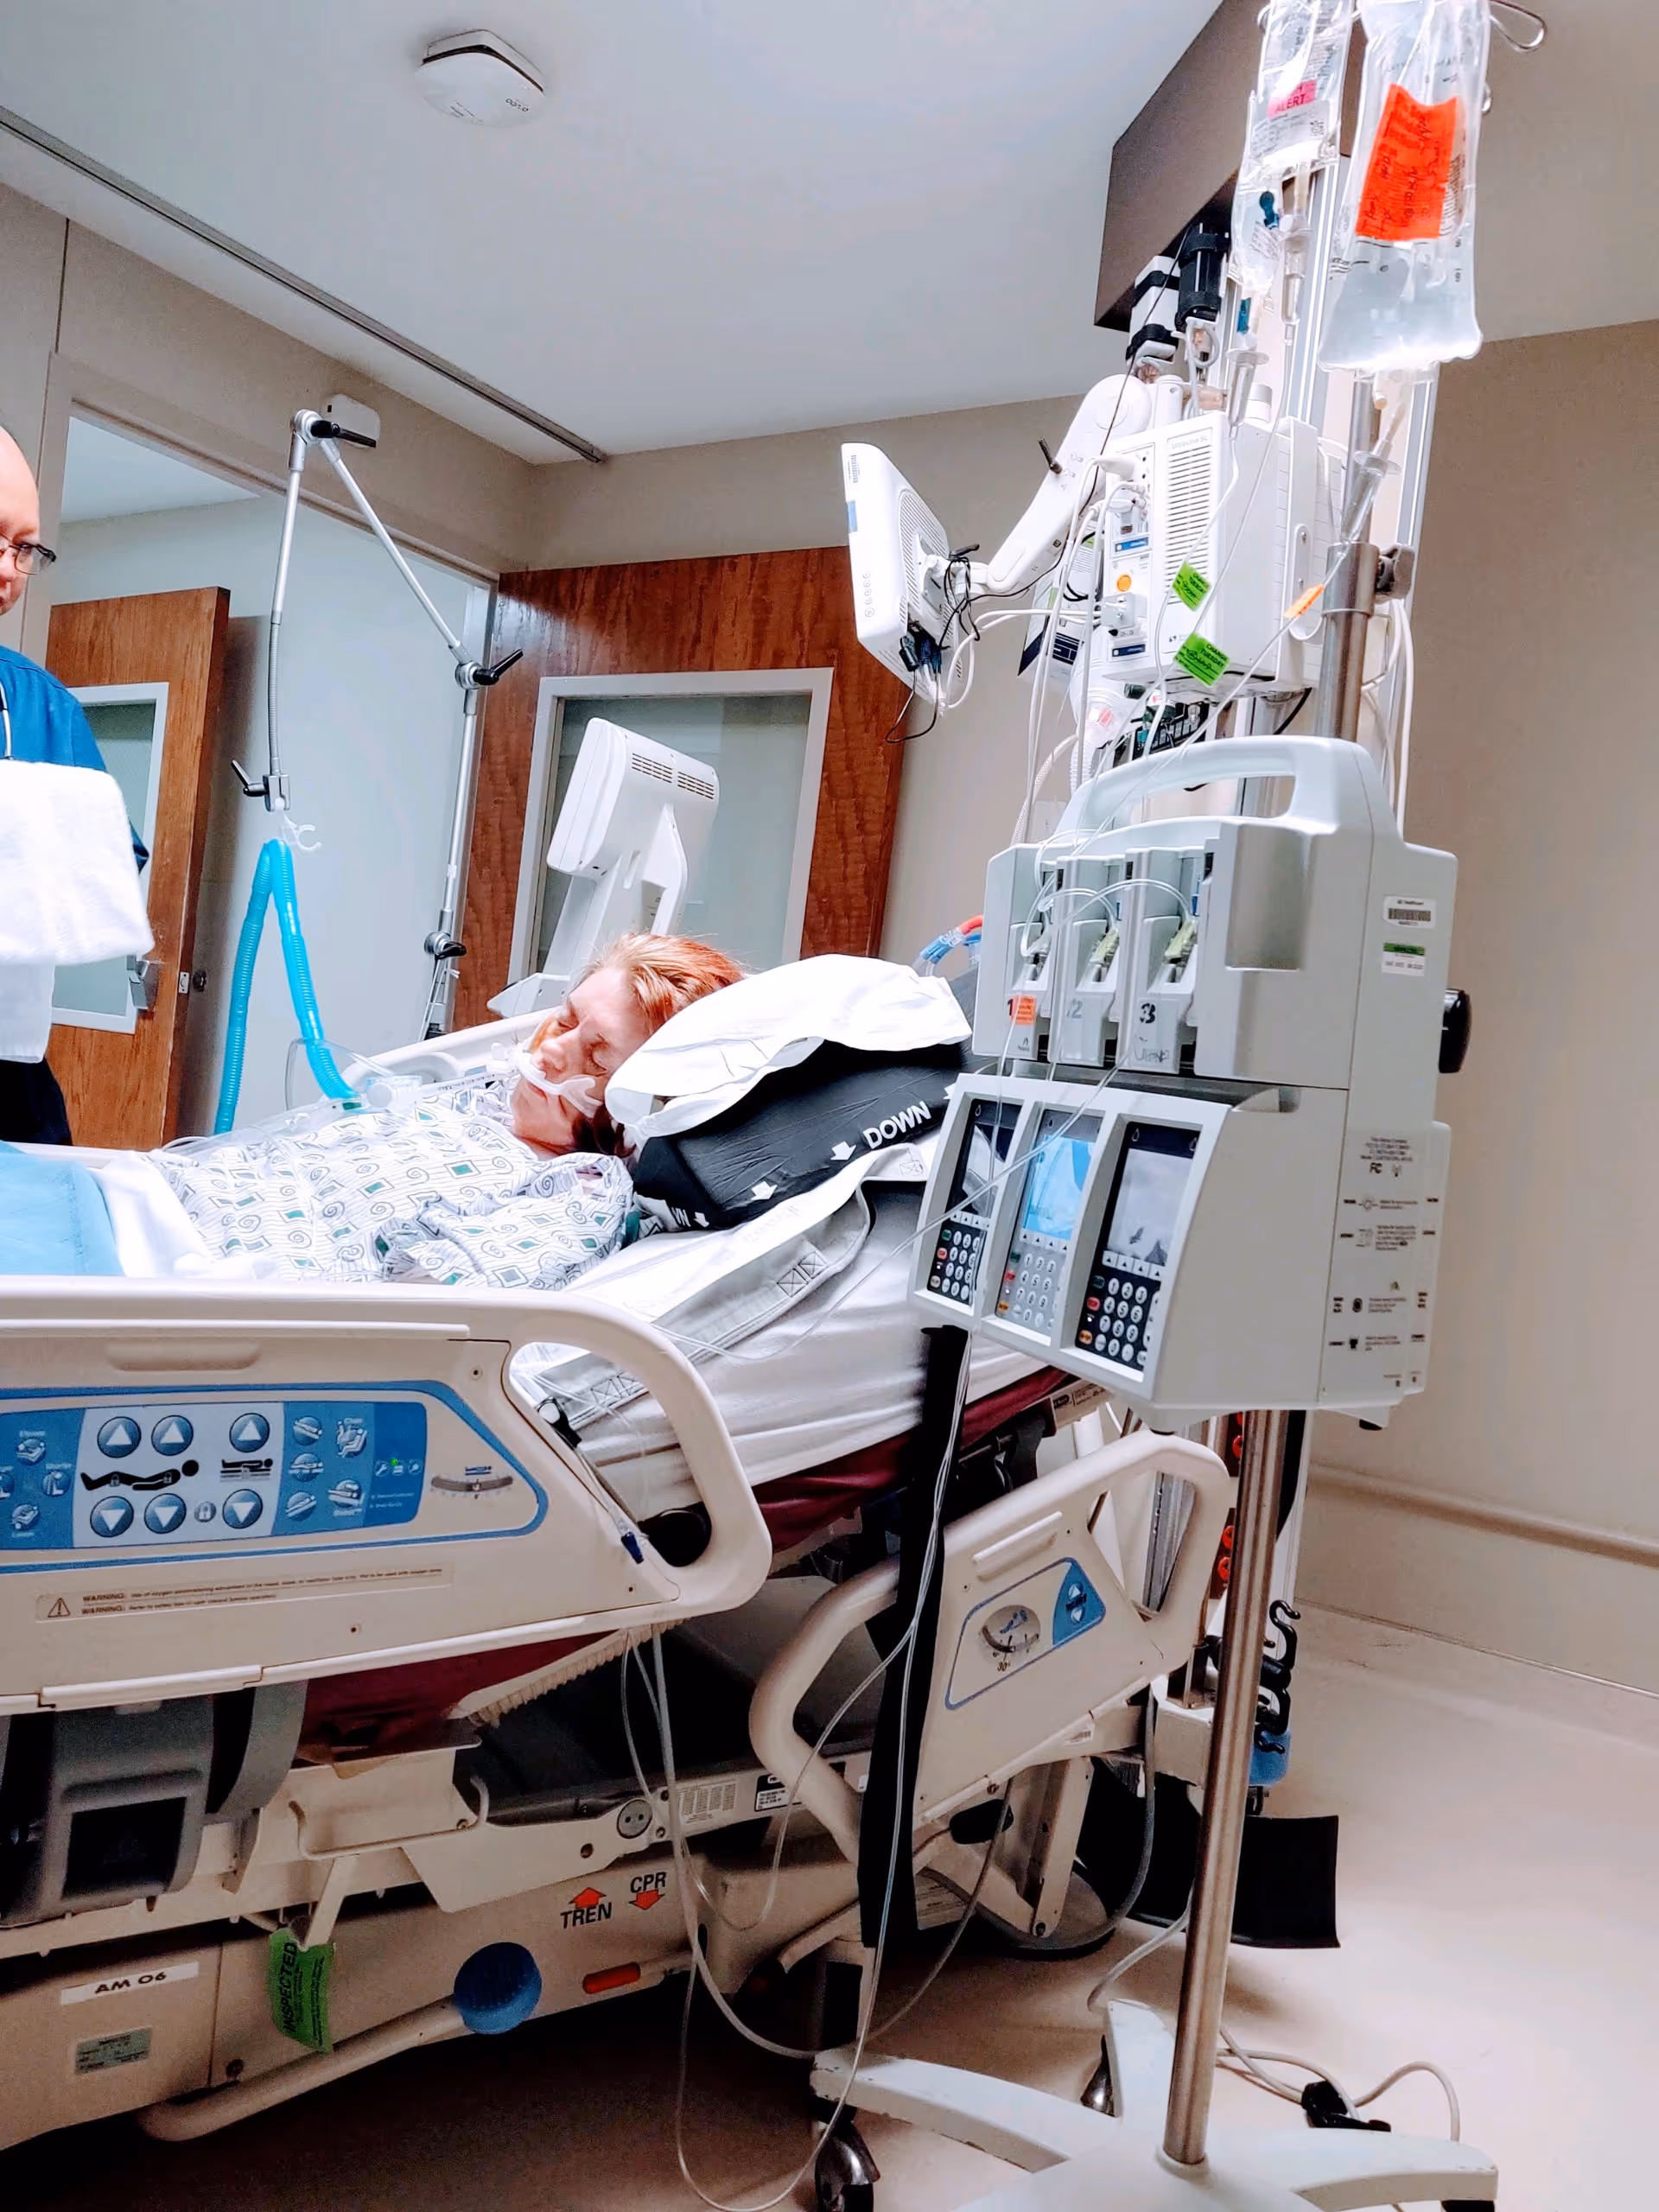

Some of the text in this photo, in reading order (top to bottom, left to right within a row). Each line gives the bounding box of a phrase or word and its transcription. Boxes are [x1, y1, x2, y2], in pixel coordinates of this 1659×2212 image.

[1274, 93, 1306, 113] ALERT
[1140, 1002, 1157, 1024] 3
[863, 1101, 931, 1149] DOWN
[630, 1872, 667, 1894] CPR
[560, 1902, 612, 1929] TREN
[95, 1972, 167, 1993] AM 06
[279, 1942, 297, 2032] INSPECTED
